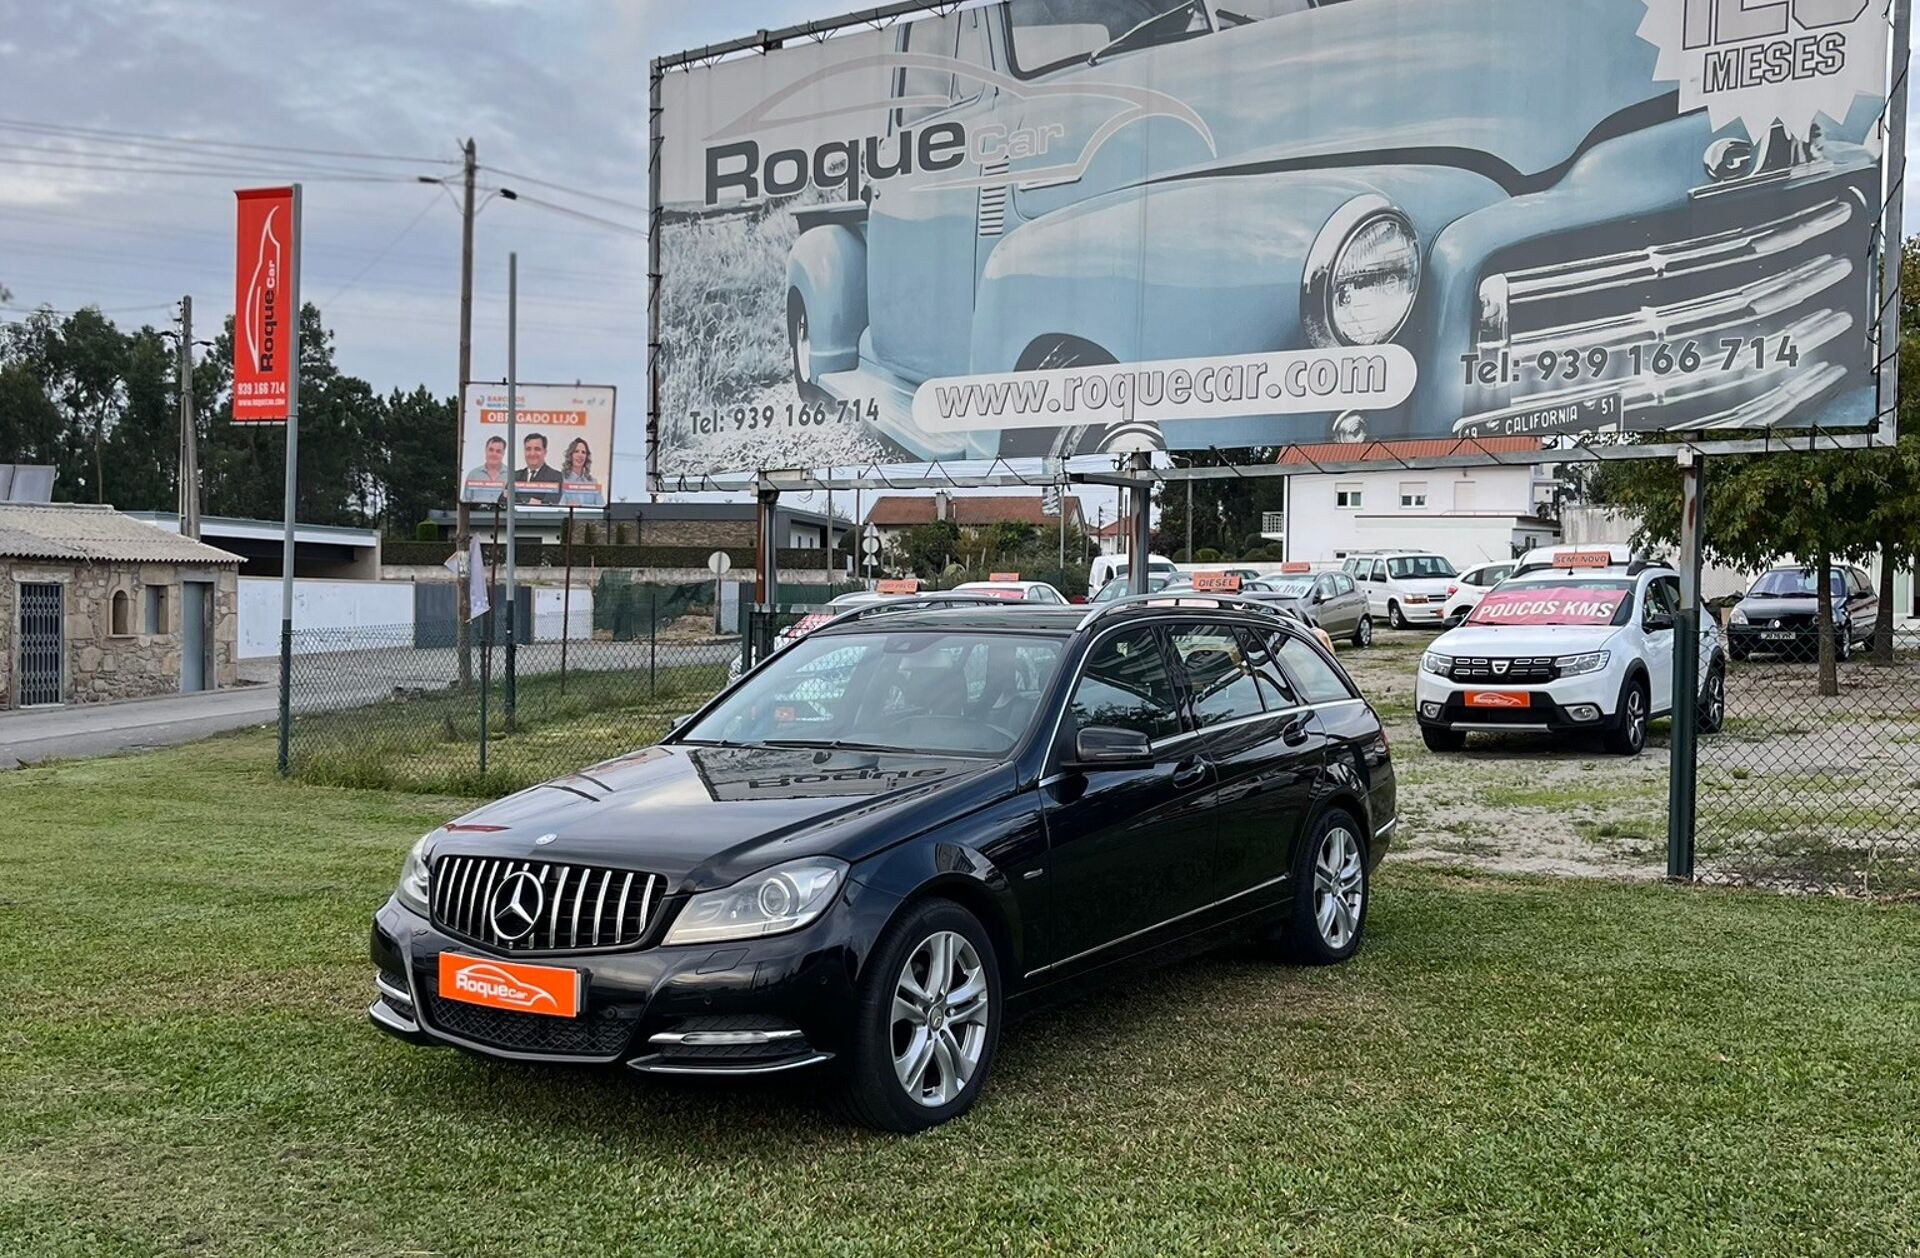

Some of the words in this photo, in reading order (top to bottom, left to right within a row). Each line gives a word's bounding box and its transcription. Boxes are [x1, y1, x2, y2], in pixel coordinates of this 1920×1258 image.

[1703, 32, 1846, 94] MESES
[1460, 353, 1520, 385] Tel:
[1536, 347, 1609, 381] 939
[1628, 341, 1702, 375] 166
[1719, 335, 1799, 371] 714
[270, 381, 286, 395] 714
[934, 354, 1387, 421] www.roquecar.com
[487, 411, 550, 424] OBRGADO
[552, 411, 579, 425] LIJÓ
[690, 410, 725, 435] Tel:
[733, 405, 775, 431] 939
[785, 402, 826, 427] 166
[836, 398, 880, 424] 714
[1505, 405, 1578, 435] CALIFORNIA
[1601, 397, 1614, 415] 51
[1554, 553, 1576, 563] SEMI
[1582, 554, 1607, 563] NOVO
[1199, 579, 1234, 587] DIESEL
[1476, 600, 1560, 620] POUCOS
[1562, 601, 1614, 617] KMS
